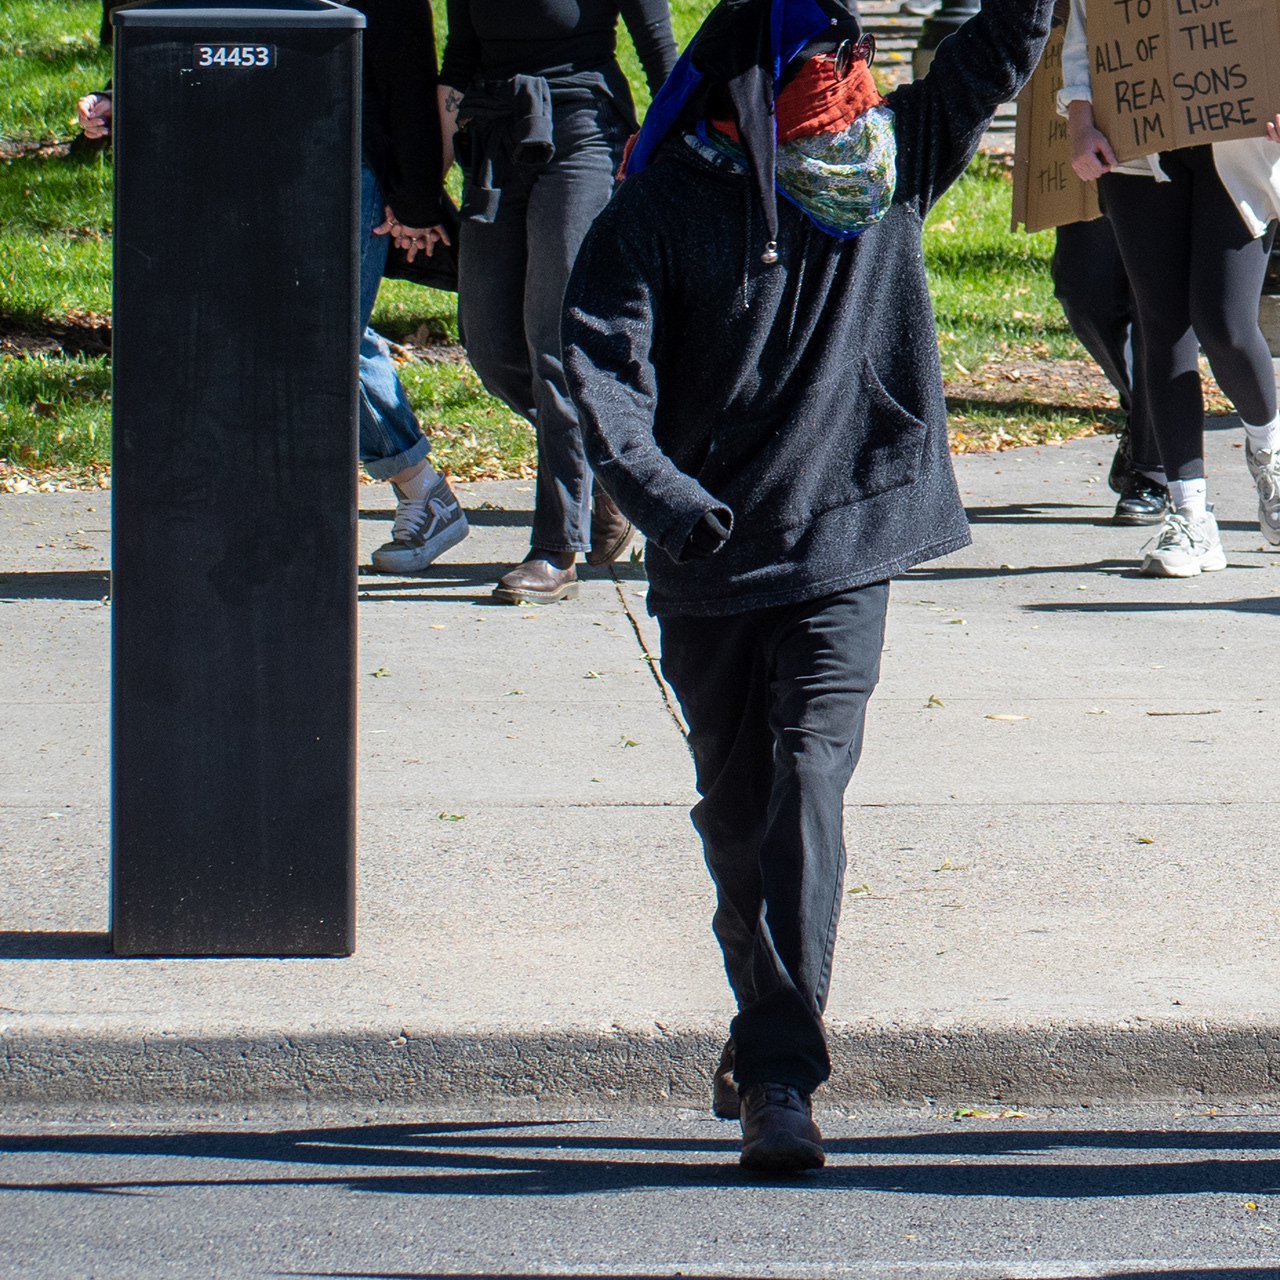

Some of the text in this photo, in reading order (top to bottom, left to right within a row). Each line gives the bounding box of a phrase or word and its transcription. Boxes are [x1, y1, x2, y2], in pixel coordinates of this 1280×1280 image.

[199, 47, 270, 67] 34453
[1096, 39, 1133, 74] ALL
[1136, 34, 1160, 62] OF
[1179, 20, 1237, 51] THE
[1133, 97, 1257, 146] IM HERE
